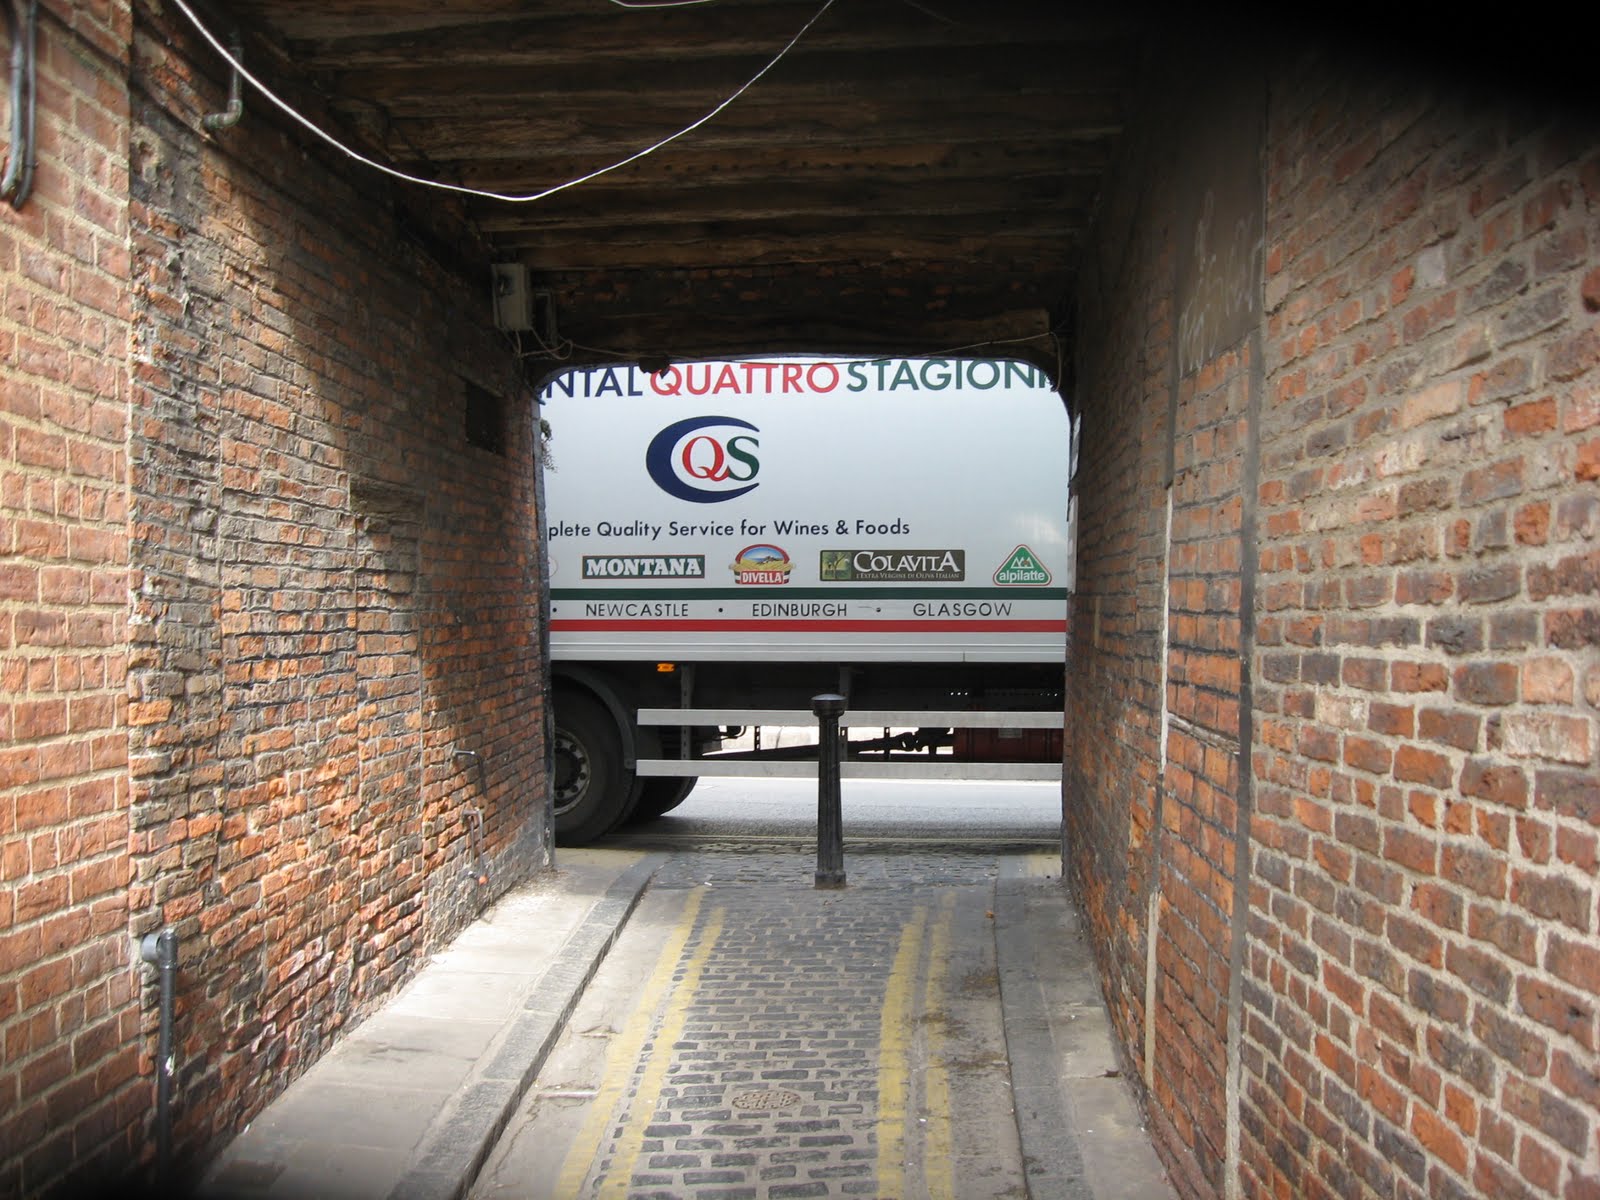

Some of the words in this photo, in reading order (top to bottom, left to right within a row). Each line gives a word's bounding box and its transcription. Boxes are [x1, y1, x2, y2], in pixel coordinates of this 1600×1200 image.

[650, 363, 839, 396] QUATTRO
[597, 520, 661, 541] Quality
[669, 521, 734, 536] Service
[741, 519, 766, 536] for
[774, 520, 829, 536] Wines
[835, 519, 849, 535] &
[856, 518, 910, 535] Foods
[586, 558, 702, 576] MONTANA
[853, 551, 961, 573] COLAVITA
[742, 572, 783, 584] DIVELLA
[999, 570, 1045, 583] alpilatte
[586, 603, 689, 617] NEWCASTLE
[752, 603, 847, 617] EDINBURGH
[913, 603, 1012, 617] GLASGOW
